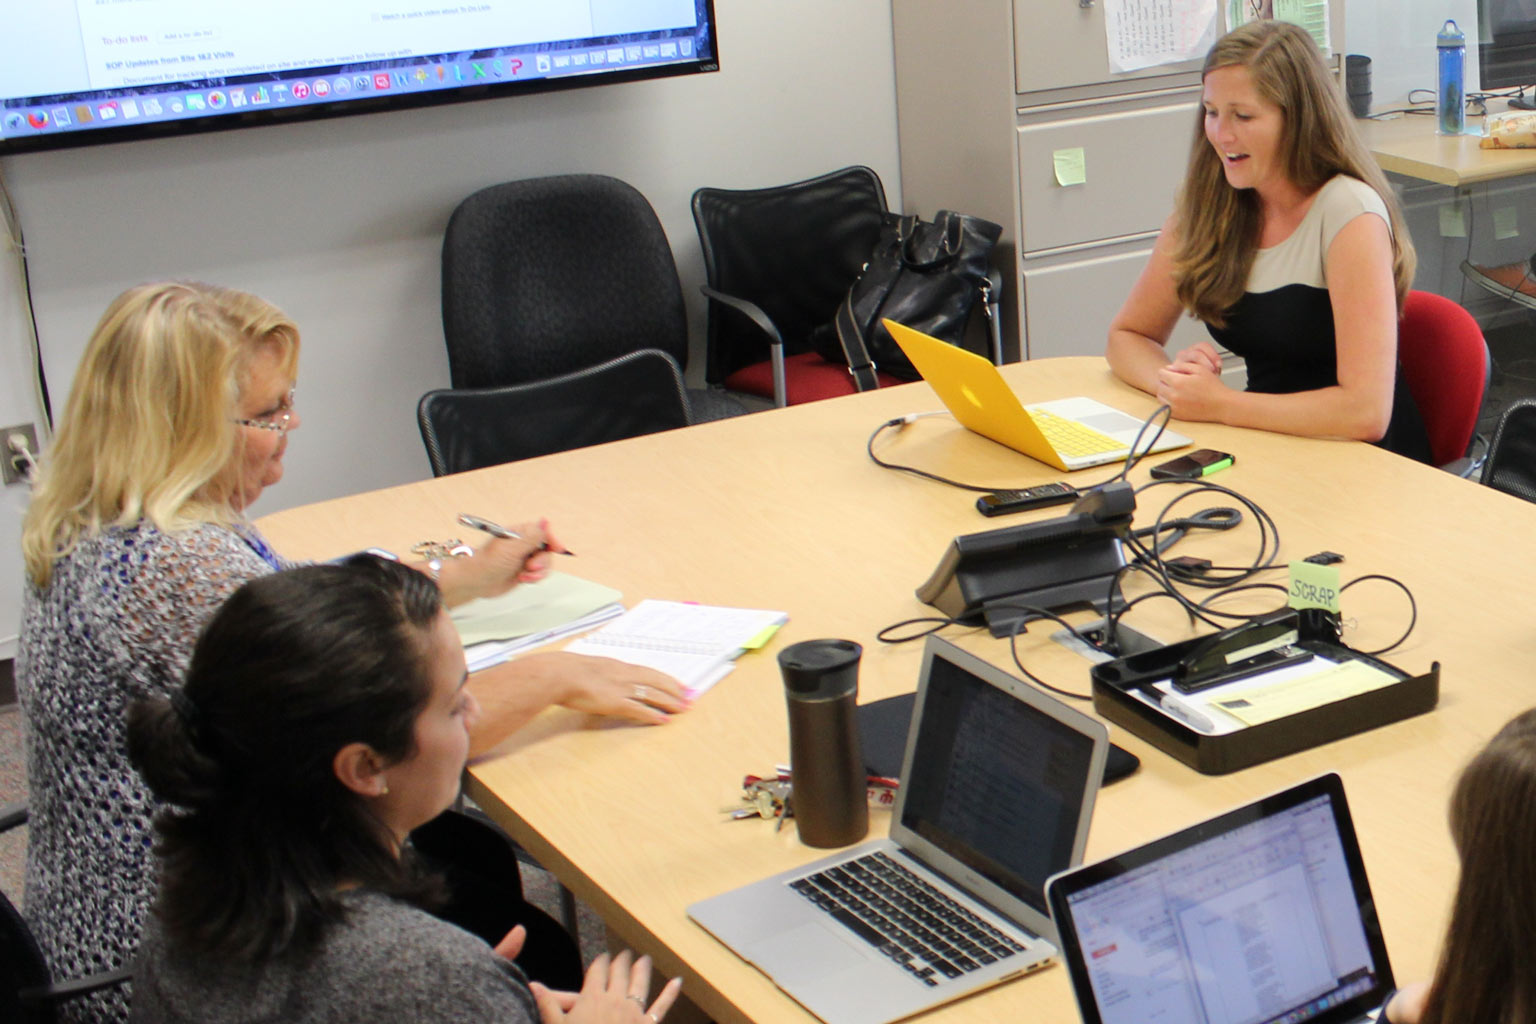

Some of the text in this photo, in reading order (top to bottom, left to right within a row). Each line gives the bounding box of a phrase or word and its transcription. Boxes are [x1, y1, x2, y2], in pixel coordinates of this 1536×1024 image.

[125, 58, 159, 70] Updates
[160, 56, 179, 65] from
[1291, 579, 1335, 607] SCRAP
